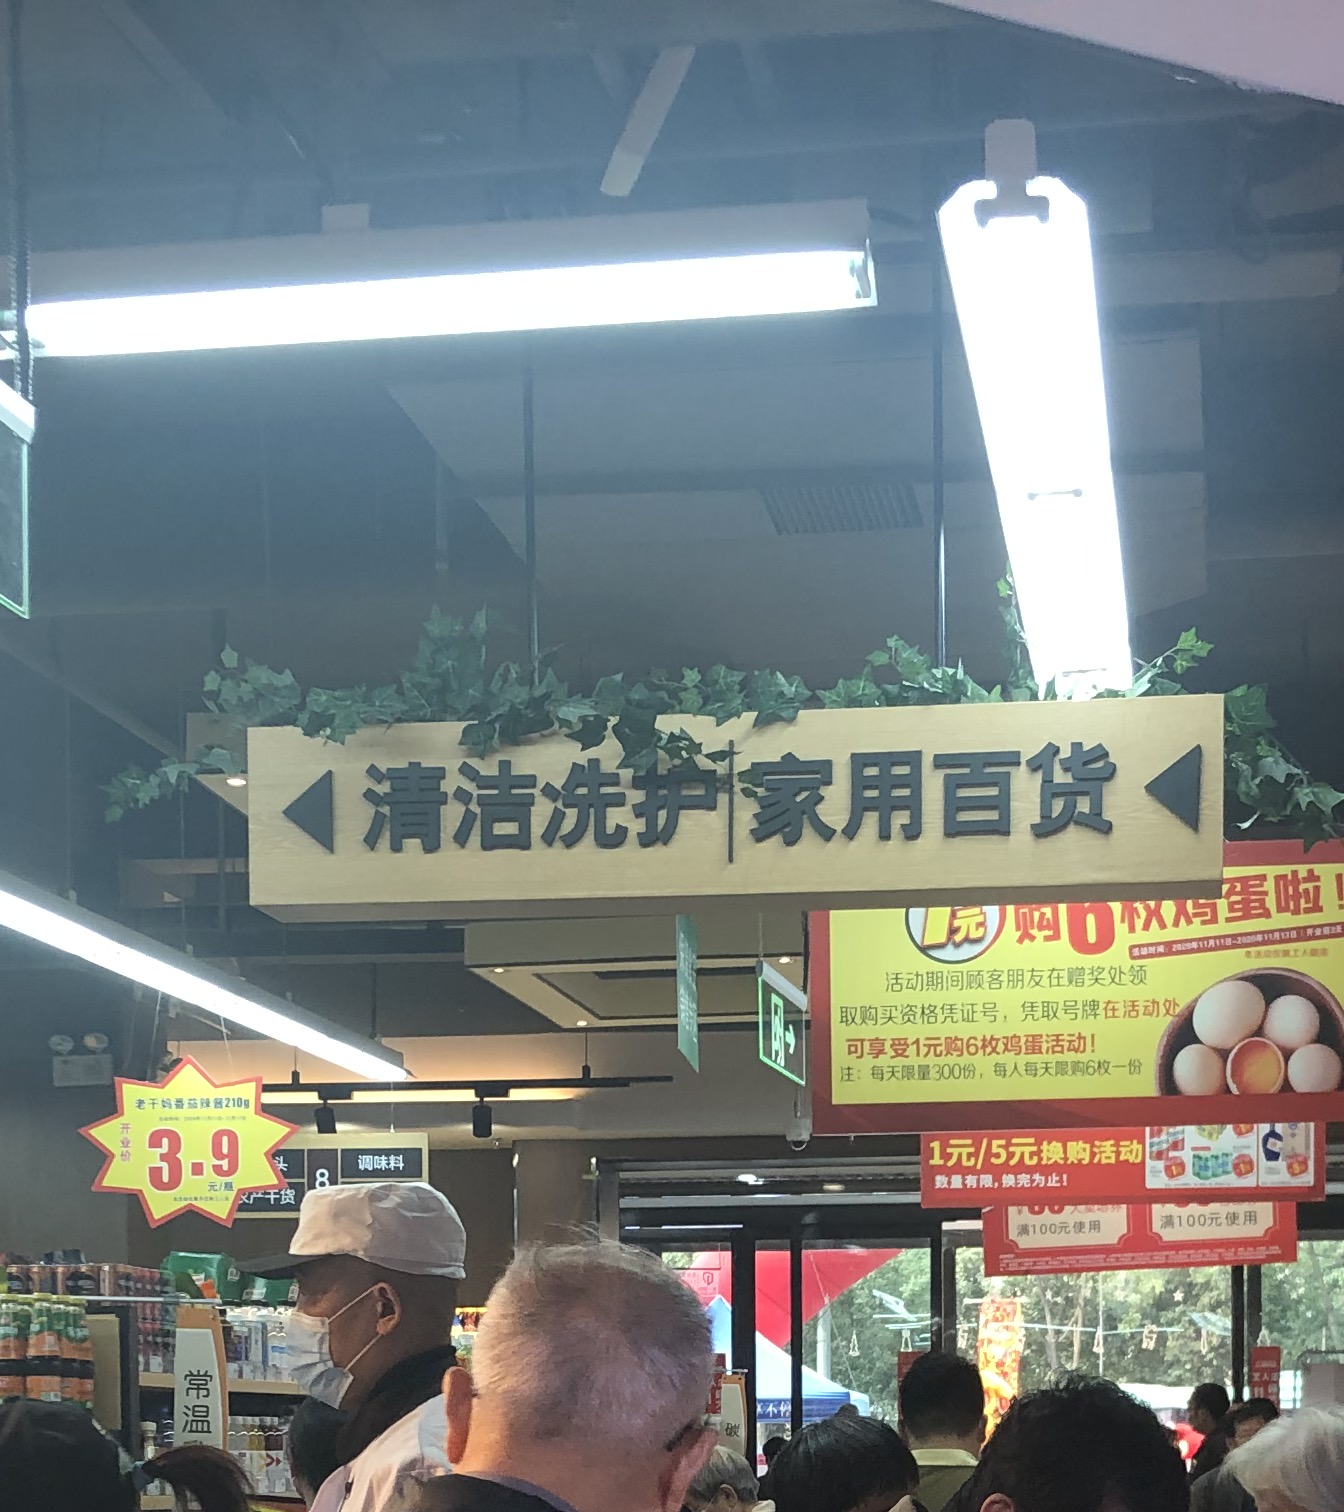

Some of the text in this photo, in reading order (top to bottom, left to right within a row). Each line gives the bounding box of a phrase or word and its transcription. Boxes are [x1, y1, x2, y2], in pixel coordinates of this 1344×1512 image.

[363, 759, 718, 854] 清洁洗护
[749, 742, 1115, 844] 家用百货
[886, 965, 1147, 993] 活动期间顾客朋友在赠奖处领
[120, 1123, 131, 1162] 开业价
[929, 1137, 1142, 1168] 1元/5元换购活动
[148, 1129, 239, 1191] 3.9
[358, 1155, 404, 1171] 调味料
[316, 1169, 330, 1189] 8
[1017, 1220, 1101, 1236] 满100元使用
[1160, 1210, 1257, 1230] 满100元使用
